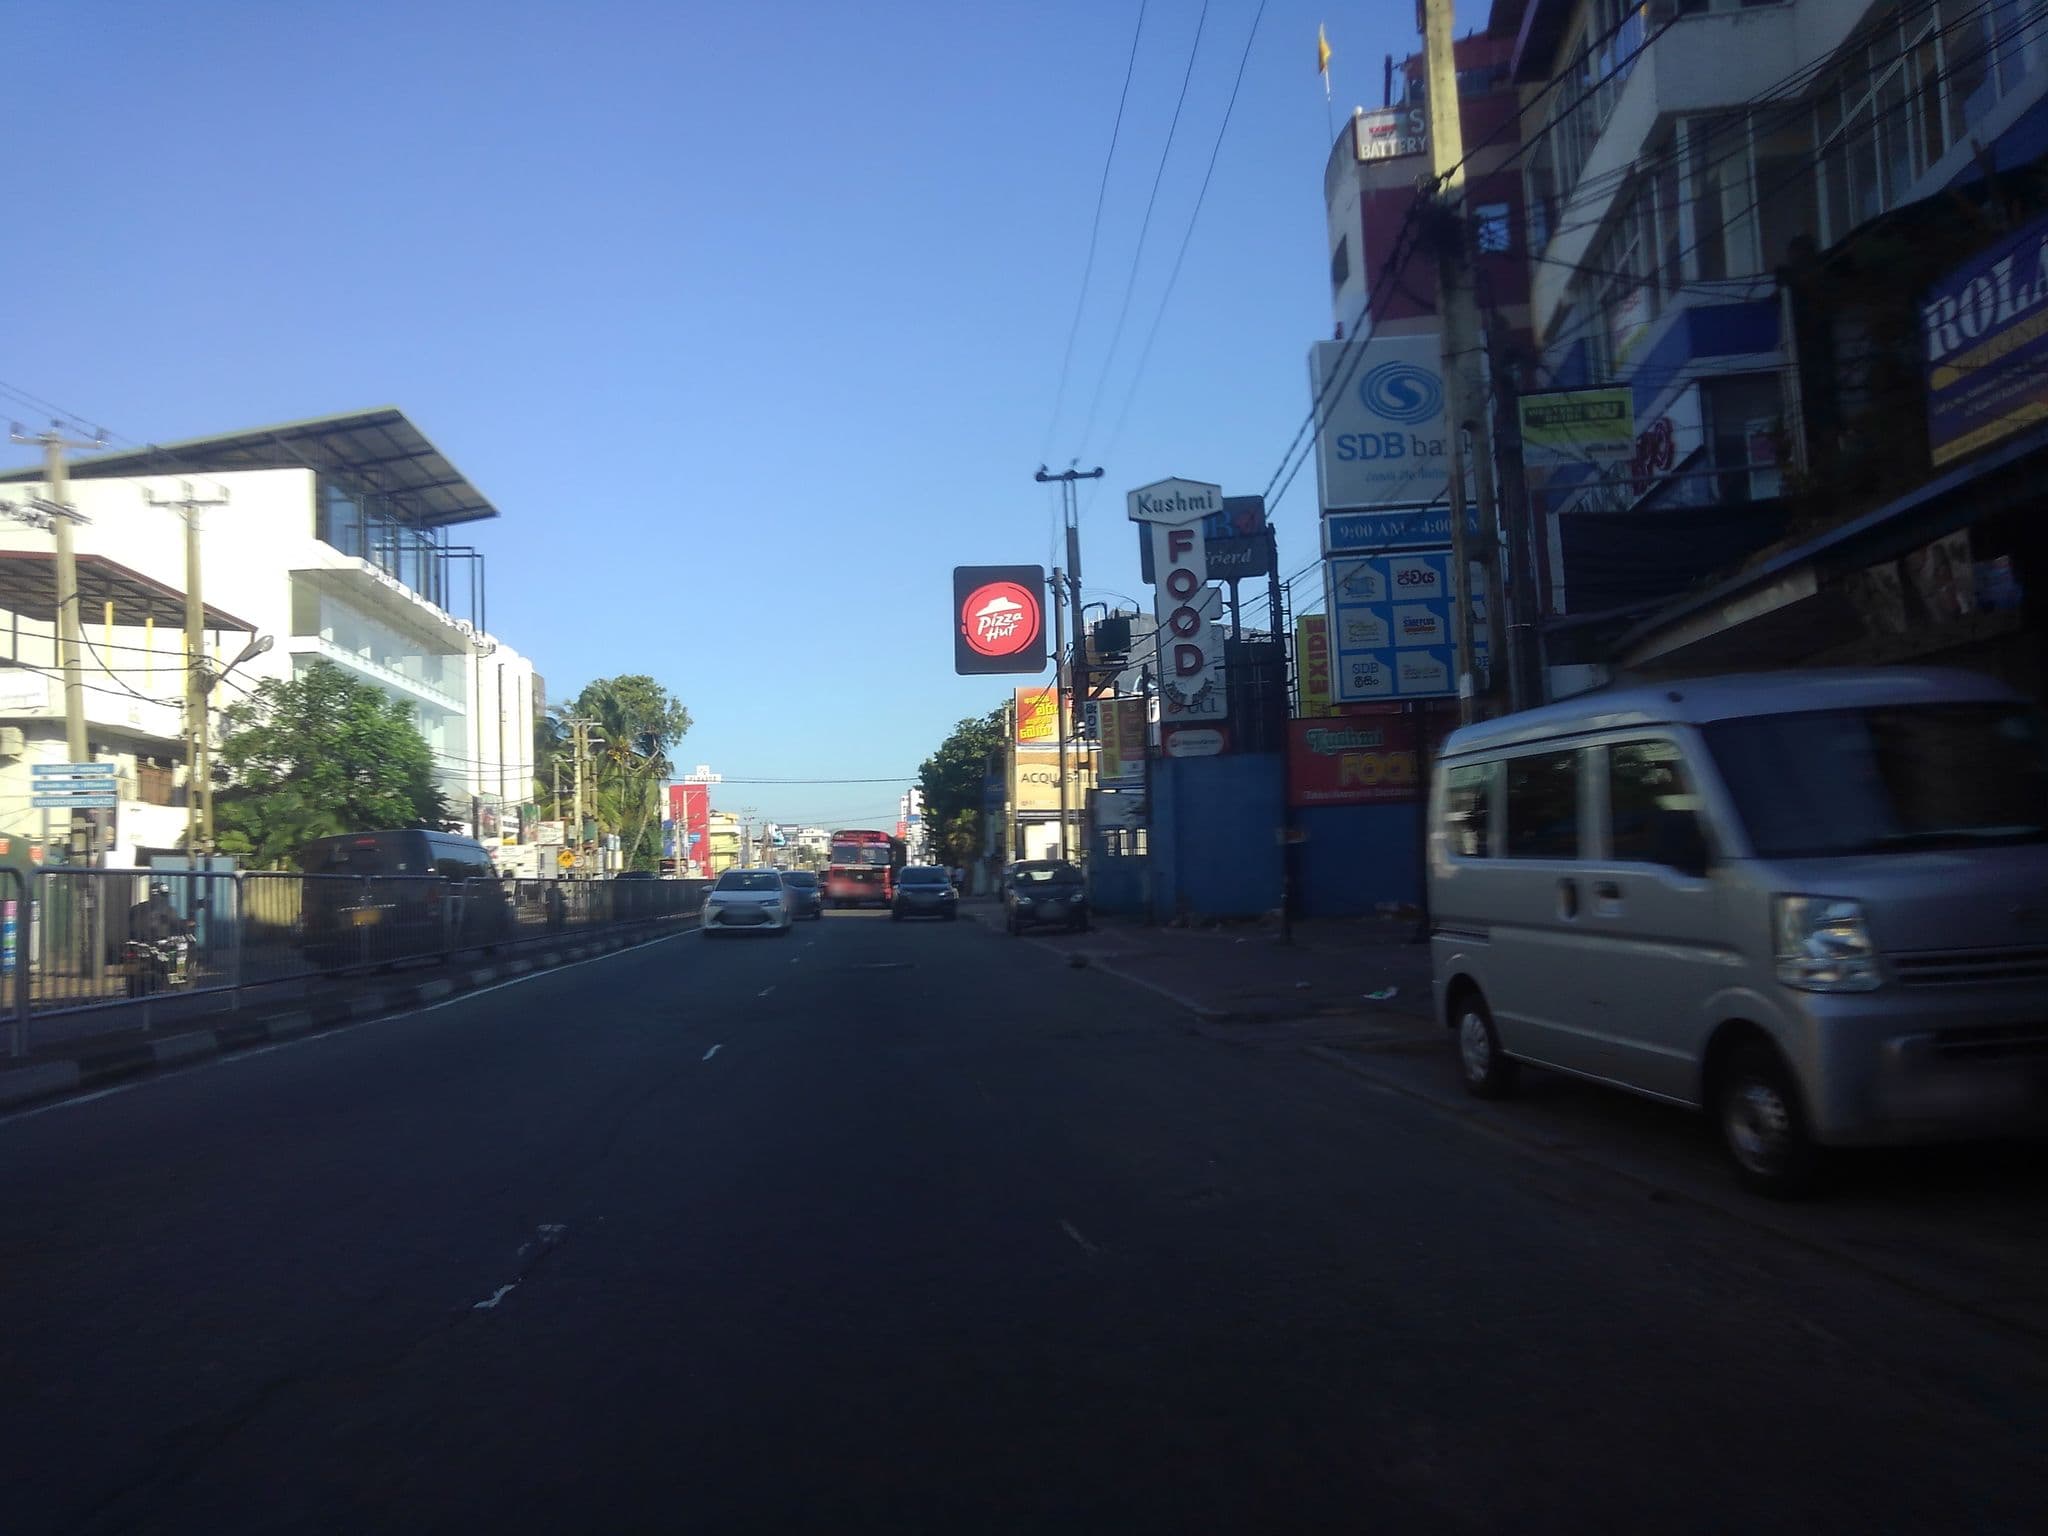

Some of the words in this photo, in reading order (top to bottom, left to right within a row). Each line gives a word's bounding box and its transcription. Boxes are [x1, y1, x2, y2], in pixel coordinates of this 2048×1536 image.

[1361, 136, 1426, 159] BATTERY
[1337, 432, 1405, 461] SDB
[1137, 490, 1214, 514] Kushmi
[1340, 523, 1372, 538] 9:00
[1167, 529, 1204, 677] FOOD
[977, 612, 1024, 636] Pizza
[986, 624, 1018, 642] Hut
[1306, 618, 1328, 694] EXIDE
[1343, 751, 1416, 785] FOO
